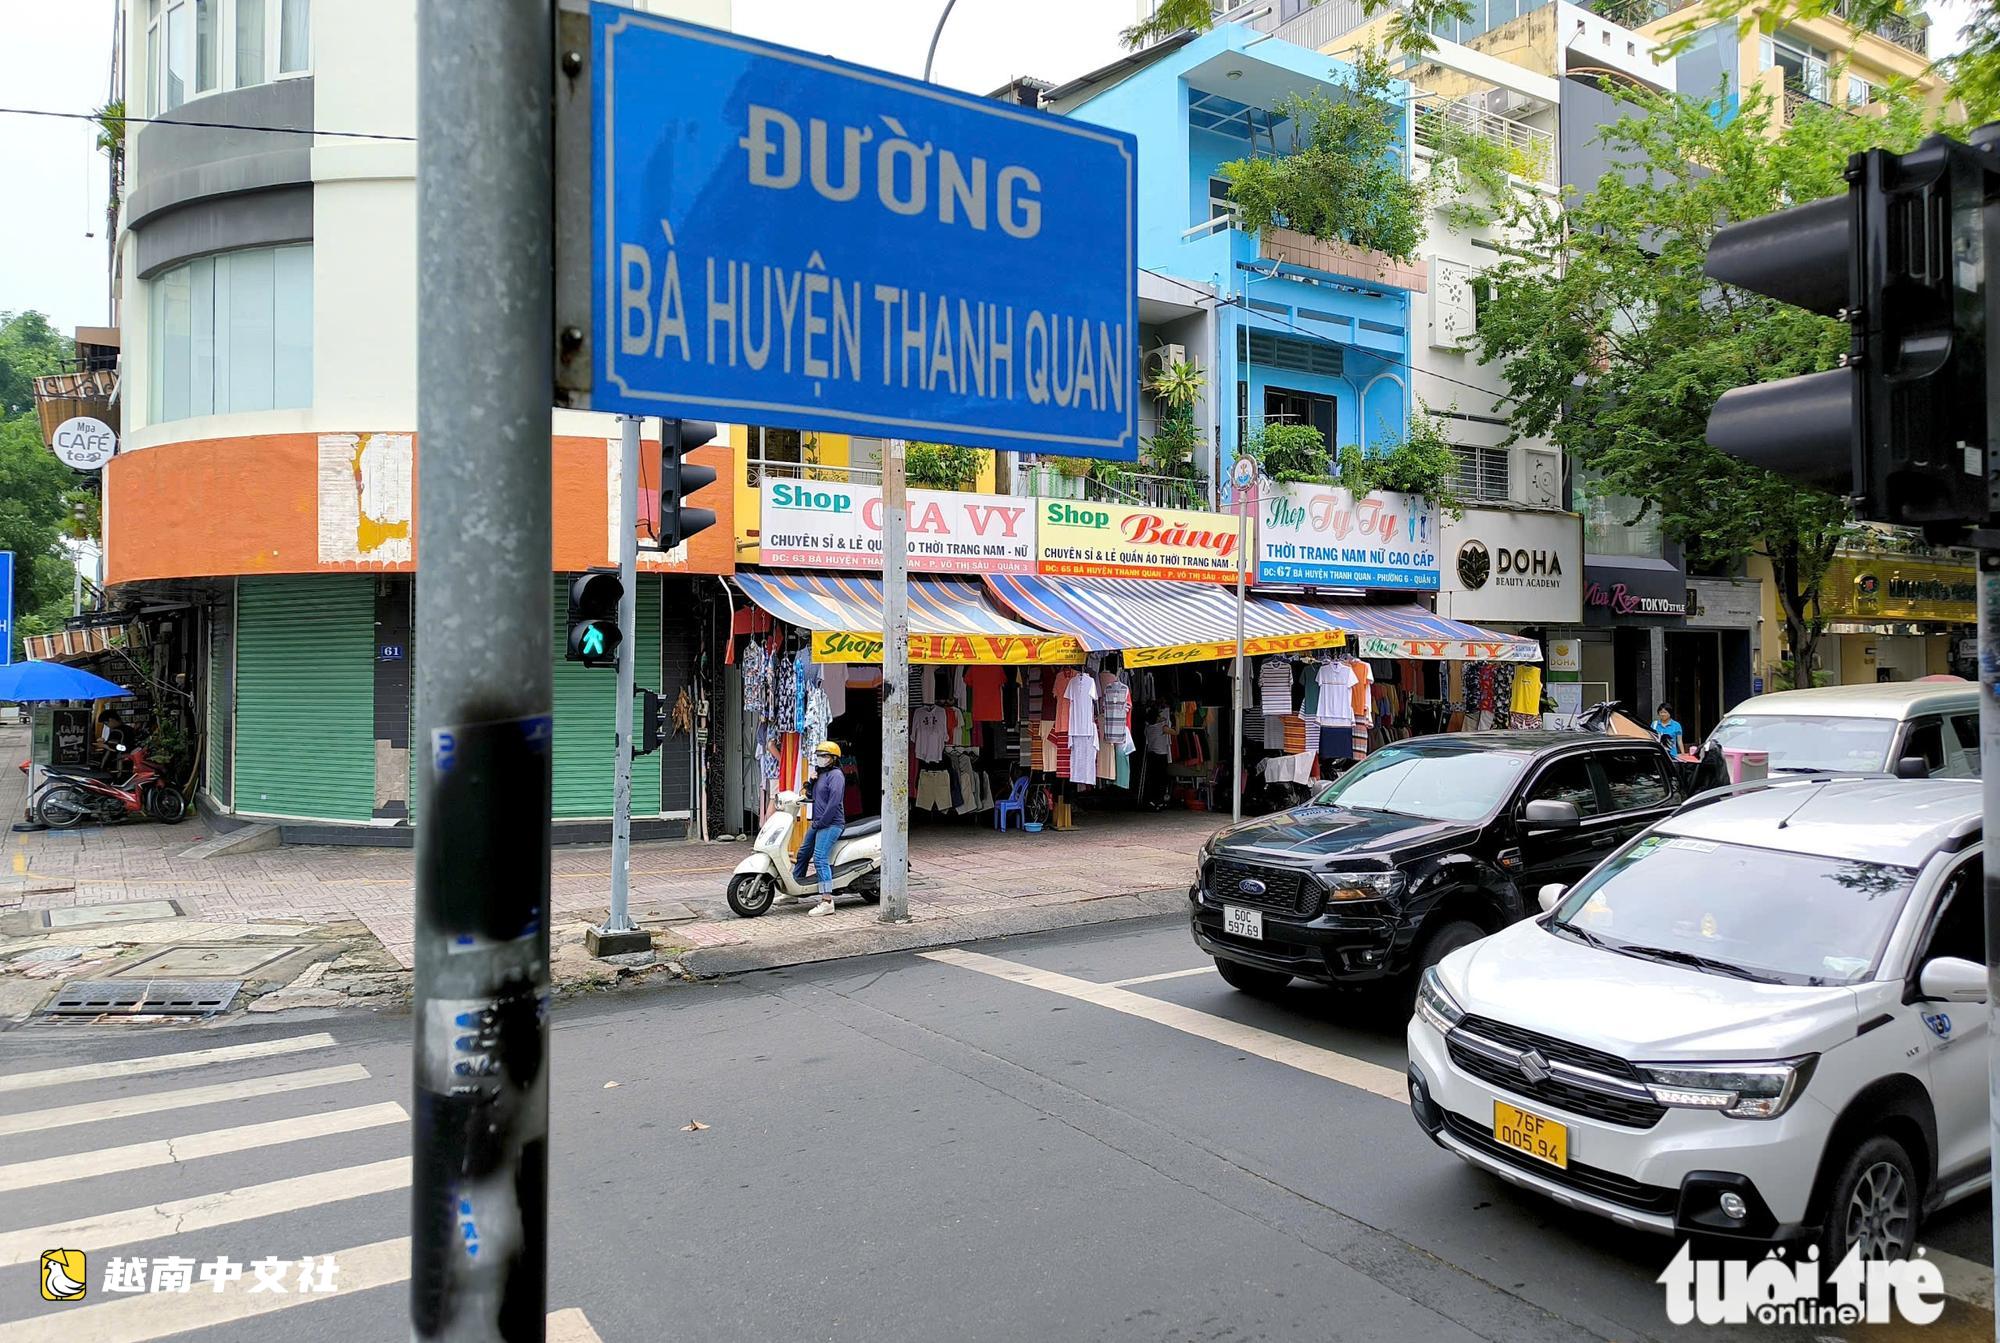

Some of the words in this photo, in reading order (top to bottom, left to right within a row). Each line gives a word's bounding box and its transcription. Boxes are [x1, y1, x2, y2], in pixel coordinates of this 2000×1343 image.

[739, 104, 1043, 239] ĐƯỜNG
[620, 218, 691, 362] BÀ
[706, 250, 862, 397] HUYỆN
[875, 285, 1014, 401] THANH
[1025, 311, 1123, 414] QUAN
[58, 432, 110, 452] CAFÉ
[772, 484, 851, 512] Shop
[964, 504, 1026, 537] VY
[1266, 496, 1305, 532] Shop
[1309, 494, 1353, 541] Ty
[1356, 498, 1398, 544] Ty
[1047, 504, 1109, 528] Shop
[1121, 514, 1239, 557] Băng
[770, 533, 818, 548] CHUYÊN
[837, 538, 846, 549] &
[850, 534, 862, 550] LẺ
[920, 540, 944, 554] THỜI
[946, 543, 980, 555] TRANG
[984, 544, 1004, 556] NAM
[1014, 544, 1028, 557] NỮ
[1266, 541, 1295, 558] THỜI
[1299, 546, 1338, 560] TRANG
[1342, 548, 1366, 563] NAM
[1370, 548, 1386, 564] NỮ
[1389, 552, 1410, 565] CAO
[1414, 549, 1434, 566] CẤP
[792, 554, 805, 562] 63
[1044, 546, 1082, 560] CHUYÊN
[1096, 551, 1102, 560] &
[1106, 548, 1116, 561] LẺ
[1146, 552, 1157, 564] ÁO
[1160, 553, 1180, 565] THỜI
[1183, 556, 1209, 567] TRANG
[1212, 559, 1228, 568] NAM
[1497, 548, 1562, 576] DOHA
[1277, 566, 1291, 577] 67
[1330, 570, 1352, 580] THANH
[1354, 572, 1371, 582] QUAN
[1496, 577, 1524, 587] BEAUTY
[1526, 578, 1560, 588] ACADEMY
[1640, 598, 1668, 611] TOKYO
[1668, 604, 1685, 612] STYLE
[384, 646, 399, 656] 61
[820, 632, 883, 659] Shop
[984, 637, 1050, 660] VY
[1133, 648, 1200, 662] Shop
[1364, 638, 1398, 654] Shop
[1403, 641, 1451, 656] TY
[1460, 642, 1504, 658] TY
[1243, 882, 1258, 892] Ford
[1235, 910, 1251, 922] 60C
[1228, 921, 1258, 937] 597.69
[1514, 1110, 1545, 1135] 76F
[1503, 1126, 1558, 1162] 005.94
